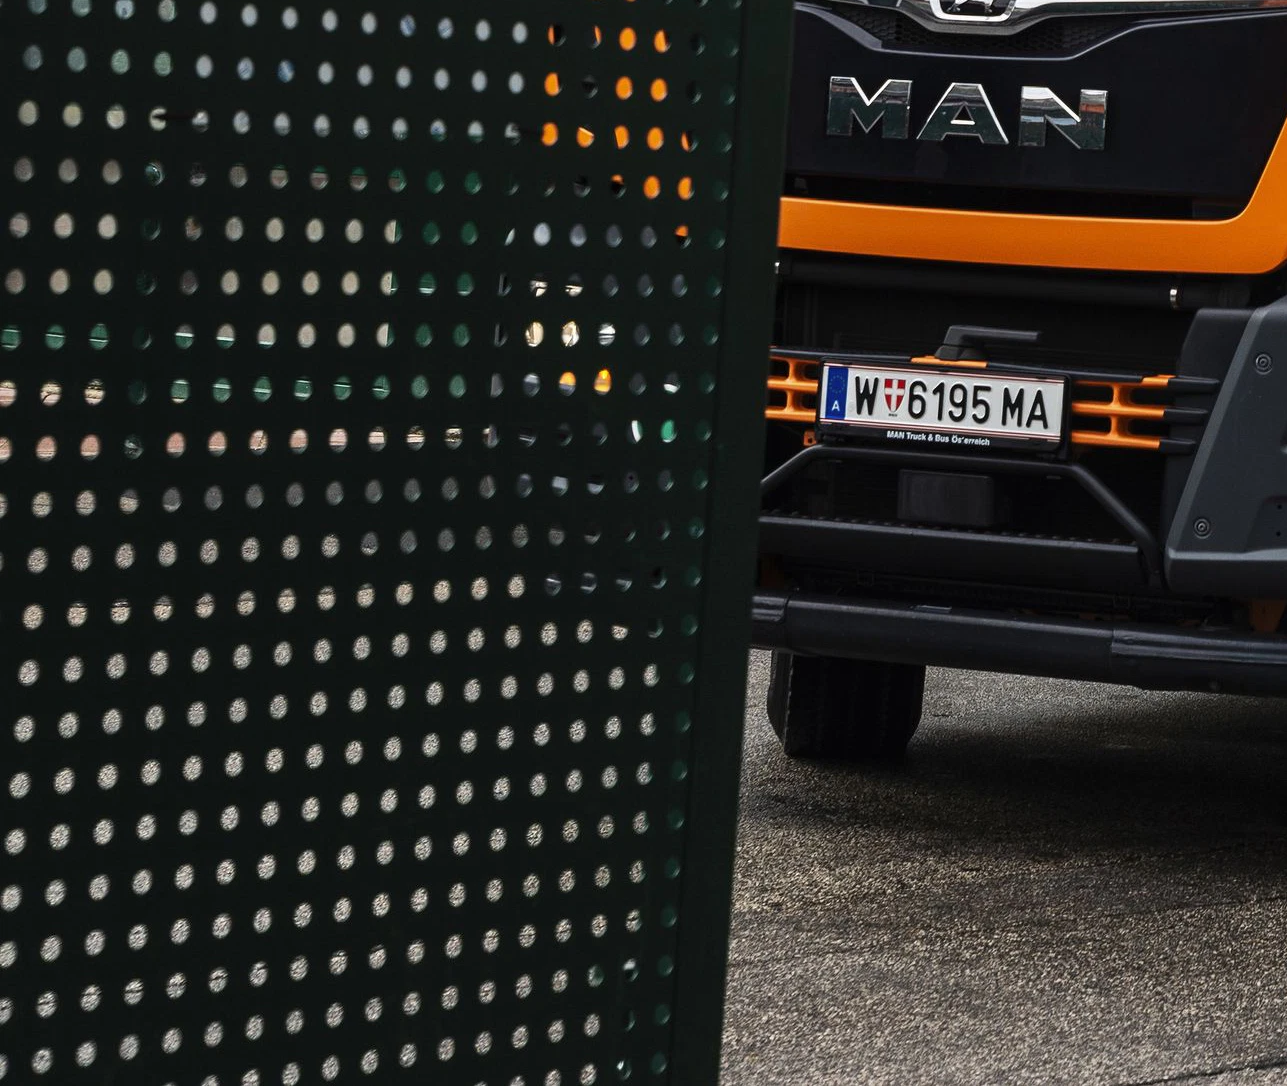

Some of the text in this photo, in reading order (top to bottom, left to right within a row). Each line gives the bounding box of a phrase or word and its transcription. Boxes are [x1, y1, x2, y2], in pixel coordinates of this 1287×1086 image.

[825, 75, 1108, 150] MAN
[832, 376, 1048, 430] A W 6195 MA
[887, 430, 904, 439] MAN
[906, 432, 926, 441] Truck
[928, 434, 934, 442] &
